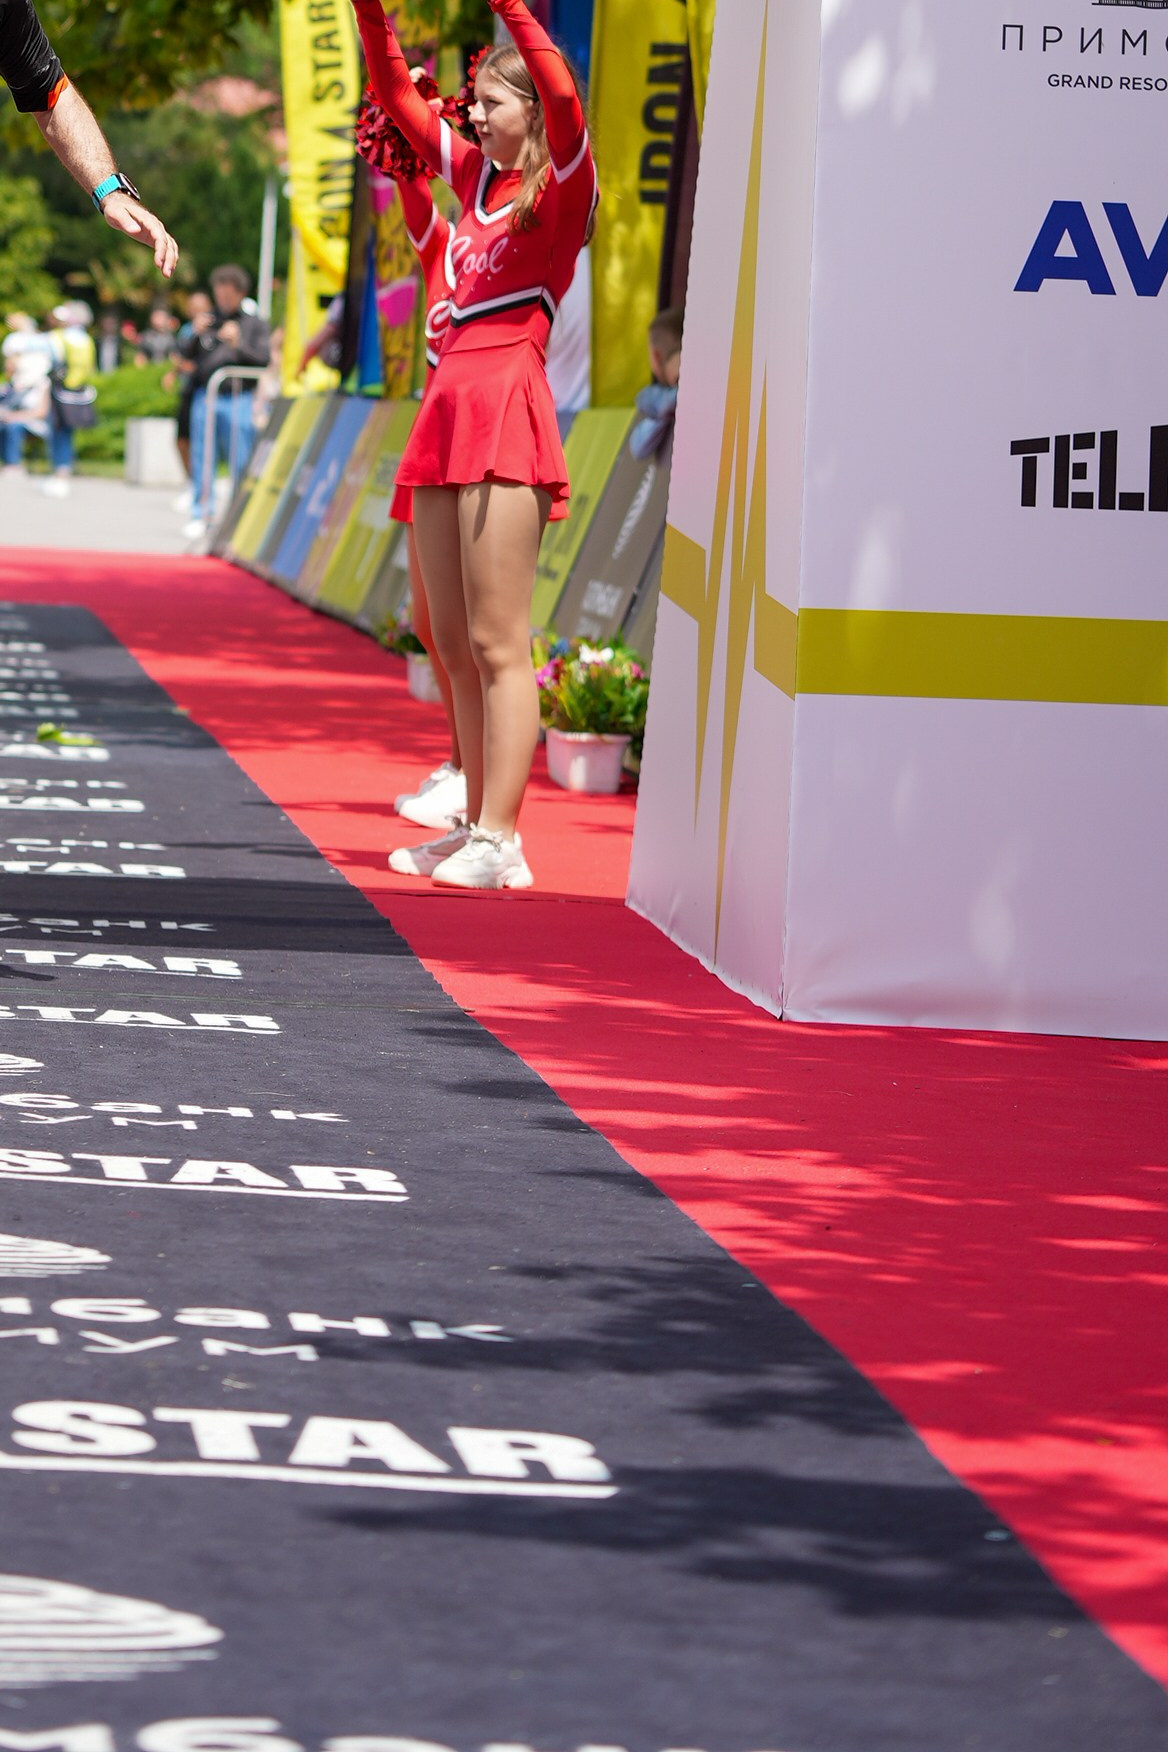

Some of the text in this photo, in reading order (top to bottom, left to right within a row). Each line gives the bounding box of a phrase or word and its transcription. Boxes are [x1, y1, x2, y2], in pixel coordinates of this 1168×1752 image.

[306, 0, 347, 103] STAR
[1001, 23, 1168, 57] ПРИМ
[1047, 73, 1114, 89] GRAND
[10, 1399, 614, 1483] STAR
